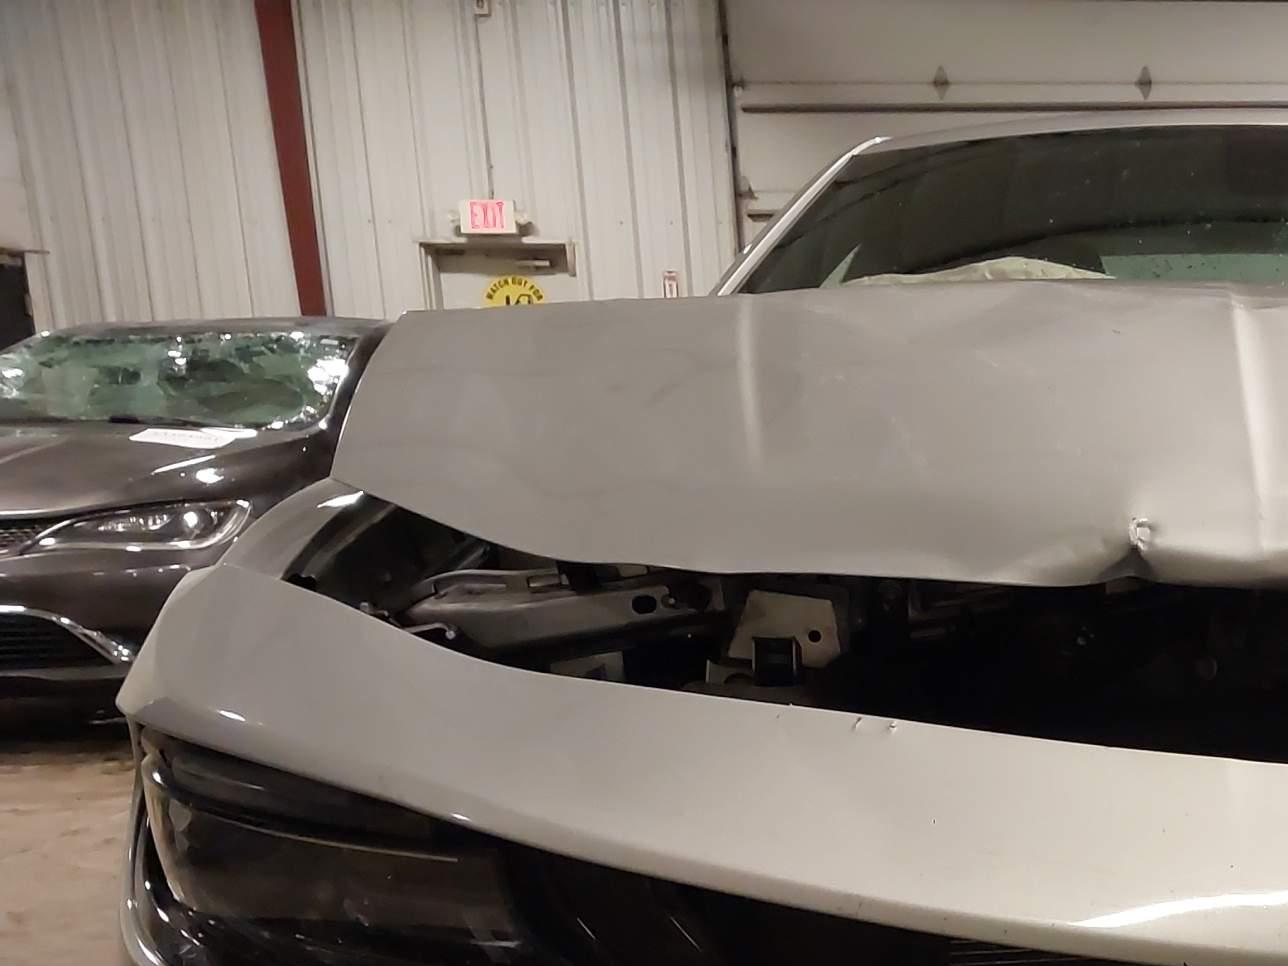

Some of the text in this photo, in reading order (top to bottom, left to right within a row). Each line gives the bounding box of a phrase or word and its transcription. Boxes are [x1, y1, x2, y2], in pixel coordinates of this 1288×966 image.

[469, 201, 504, 229] EXIT
[486, 276, 544, 301] WATCH OUT FOR
